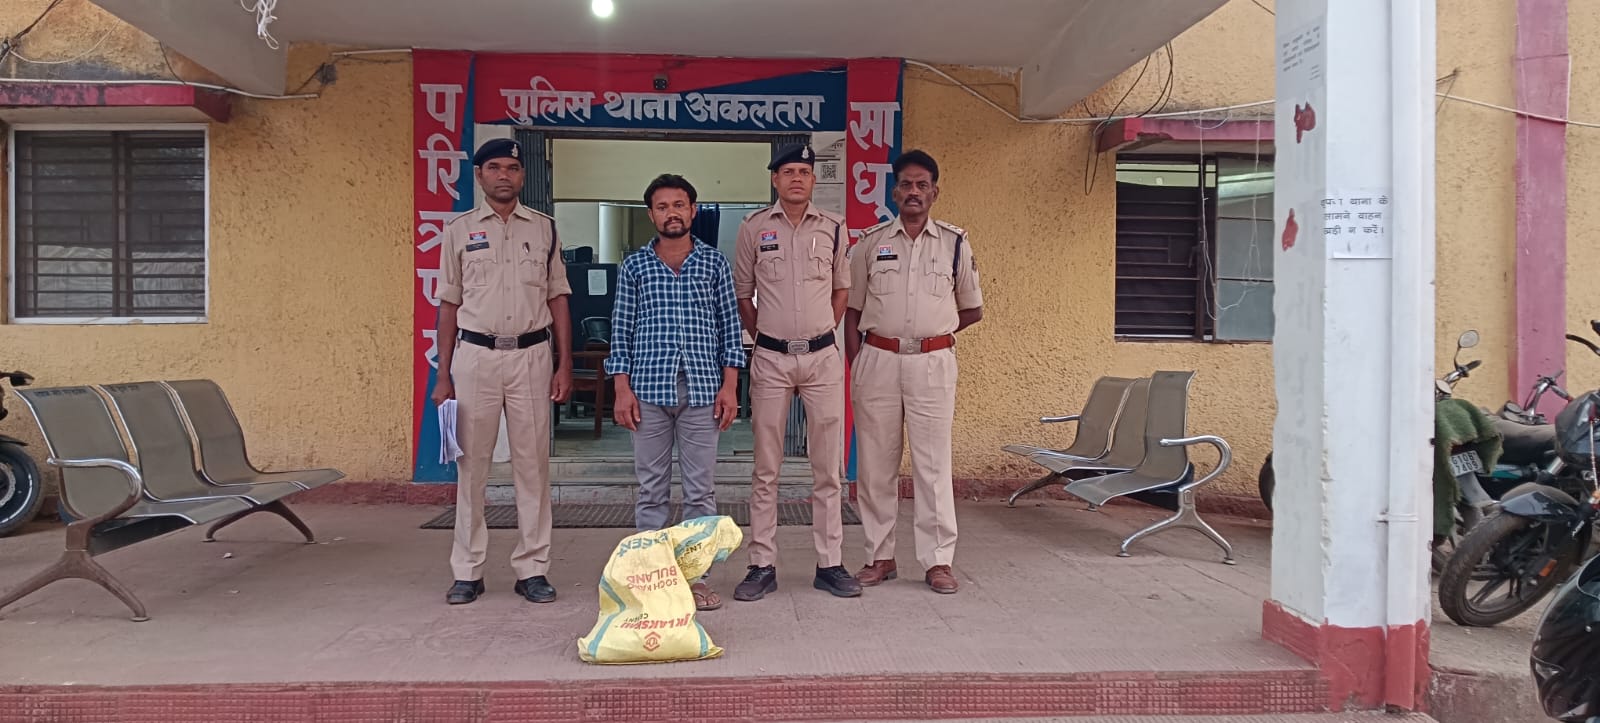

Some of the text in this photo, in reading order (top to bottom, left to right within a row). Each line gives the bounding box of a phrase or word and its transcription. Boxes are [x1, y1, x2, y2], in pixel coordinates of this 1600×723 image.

[499, 75, 825, 129] पुलिस थाना अकलतरा
[1358, 212, 1382, 220] वाहन
[1348, 226, 1356, 235] न
[626, 565, 678, 584] BULAND
[653, 578, 678, 591] SOCH
